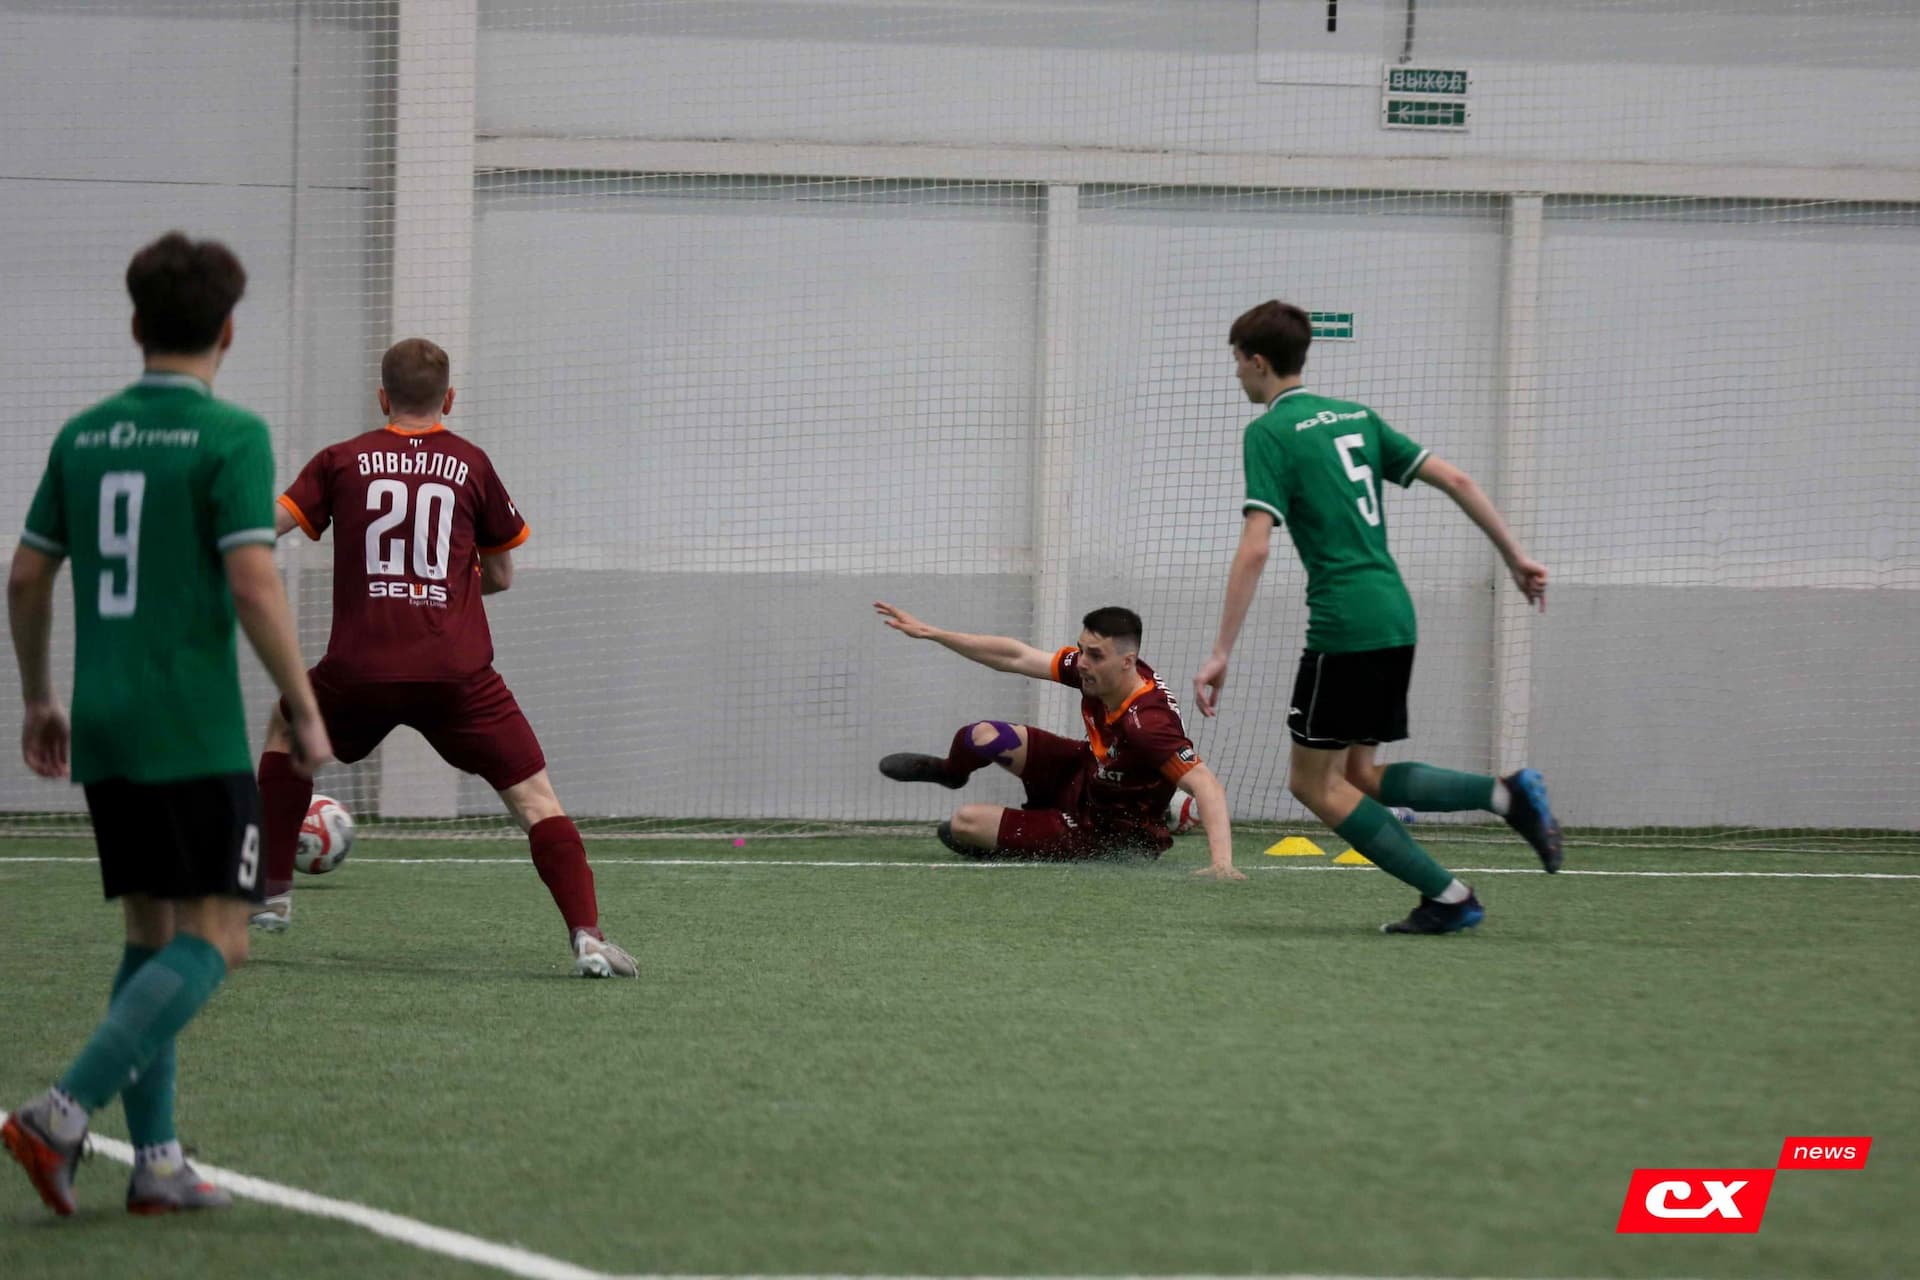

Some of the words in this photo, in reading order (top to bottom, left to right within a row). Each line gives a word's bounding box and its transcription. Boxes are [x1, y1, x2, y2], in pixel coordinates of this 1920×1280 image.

[1392, 72, 1464, 91] ВЫХОД
[357, 451, 469, 487] ЗАВЬЯЛОВ
[1334, 432, 1380, 527] 5
[98, 471, 146, 618] 9
[365, 479, 456, 580] 20
[368, 581, 448, 602] SEUS
[238, 823, 260, 891] 9
